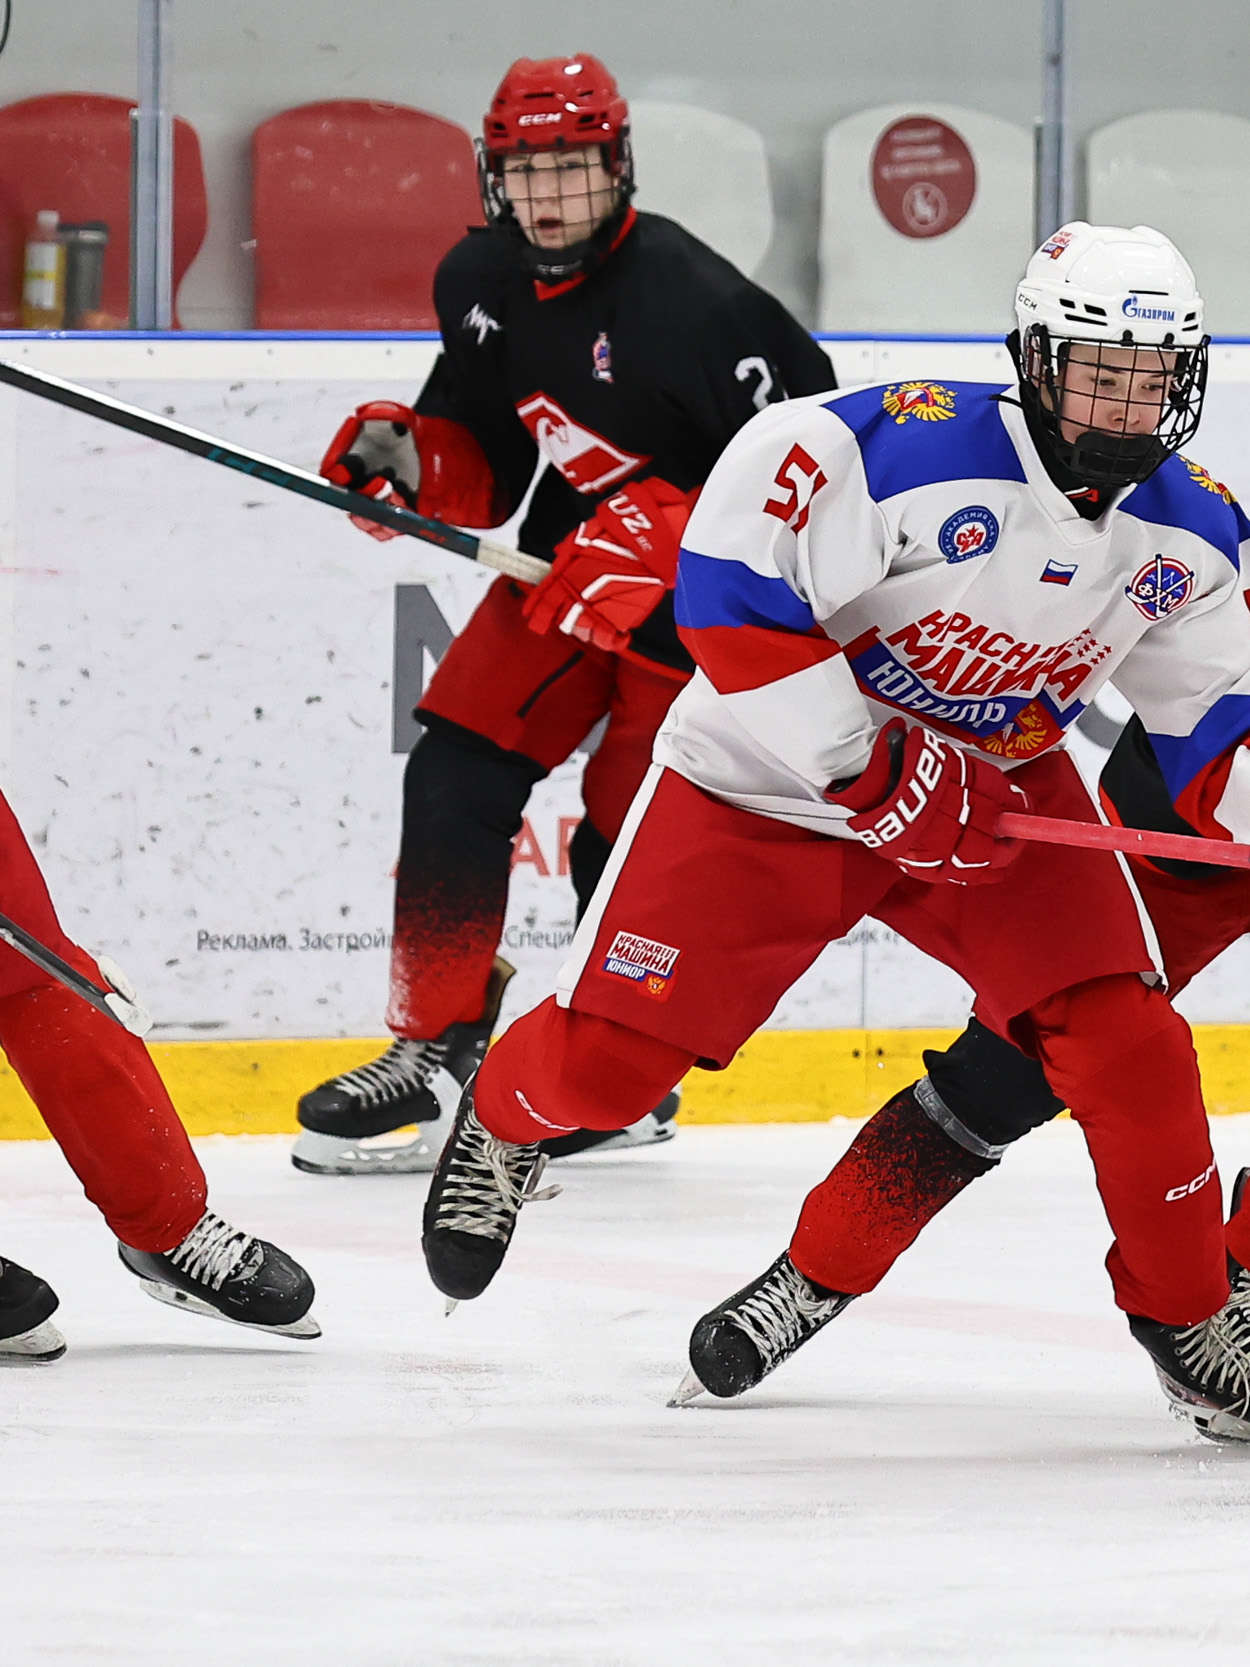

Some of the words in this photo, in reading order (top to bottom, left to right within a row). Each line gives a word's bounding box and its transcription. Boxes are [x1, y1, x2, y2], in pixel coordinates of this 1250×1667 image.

[518, 112, 562, 127] CCM
[1017, 293, 1038, 311] CCM
[1137, 308, 1176, 322] ГАЗПРОМ
[1138, 582, 1180, 609] ФХМ
[857, 728, 946, 848] BAUER
[197, 928, 293, 950] Реклама.
[504, 925, 574, 950] Специ
[618, 934, 663, 956] КРАСНАЯ
[605, 959, 646, 980] ЮНИОР
[609, 943, 671, 974] МАШИНА
